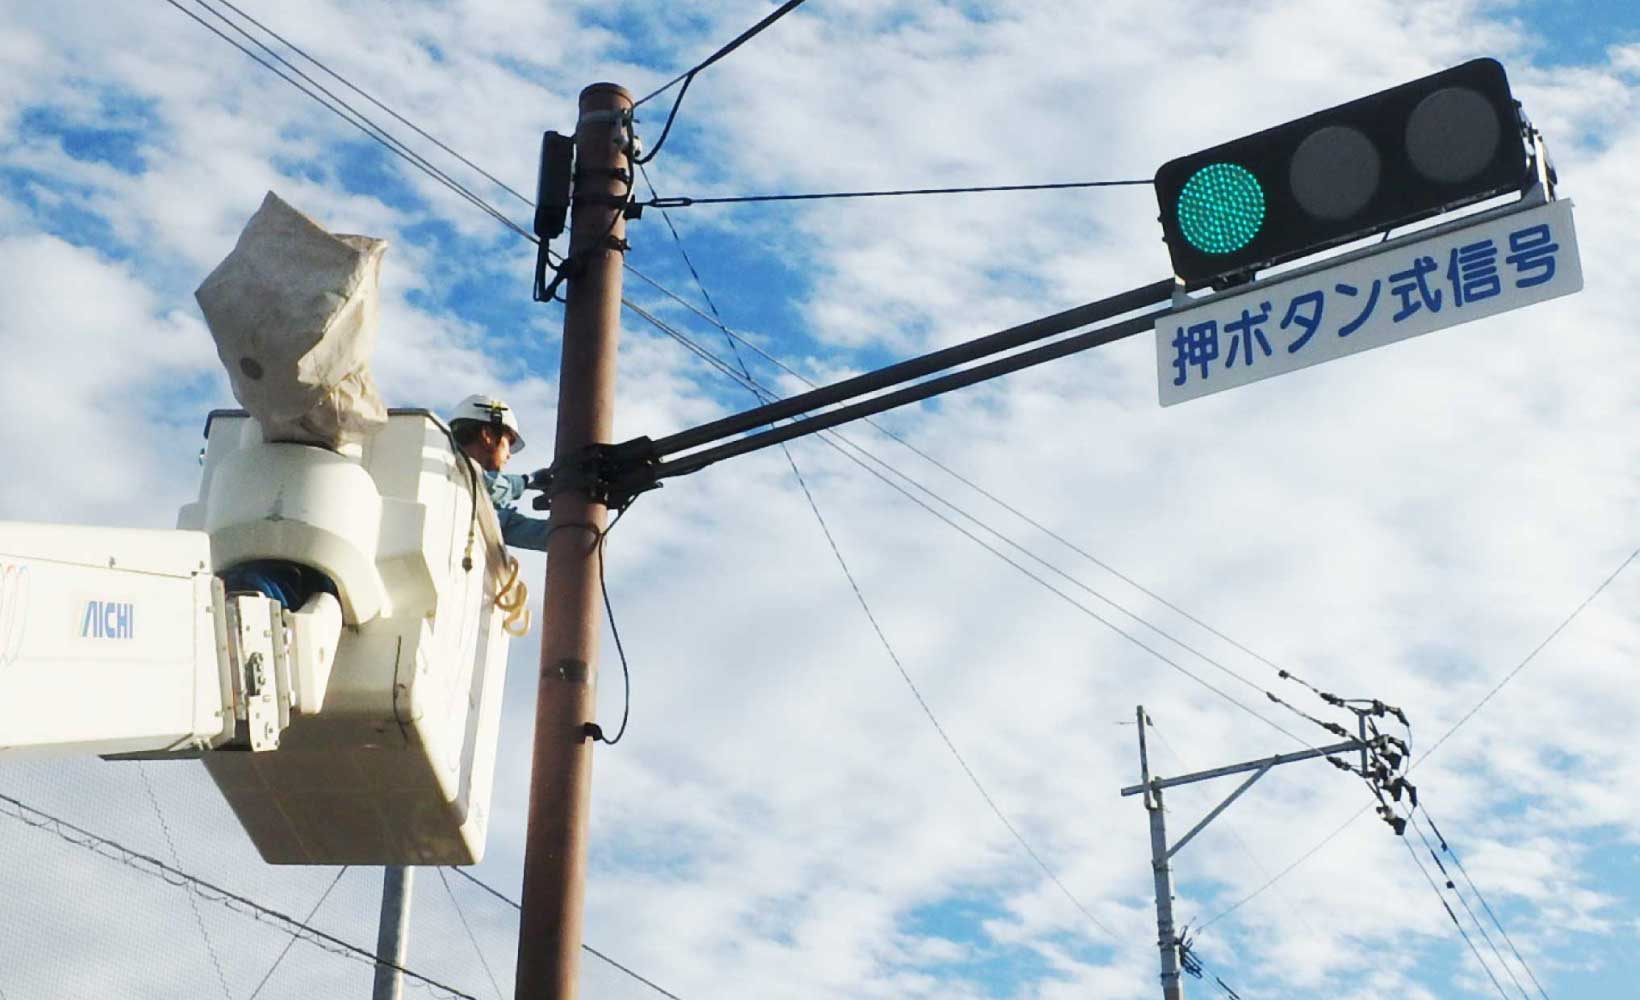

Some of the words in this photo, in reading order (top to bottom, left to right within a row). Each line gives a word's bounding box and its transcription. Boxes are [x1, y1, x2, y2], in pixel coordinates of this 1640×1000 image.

[1172, 223, 1559, 387] 押ボタン式信号
[82, 601, 133, 639] AICHI
